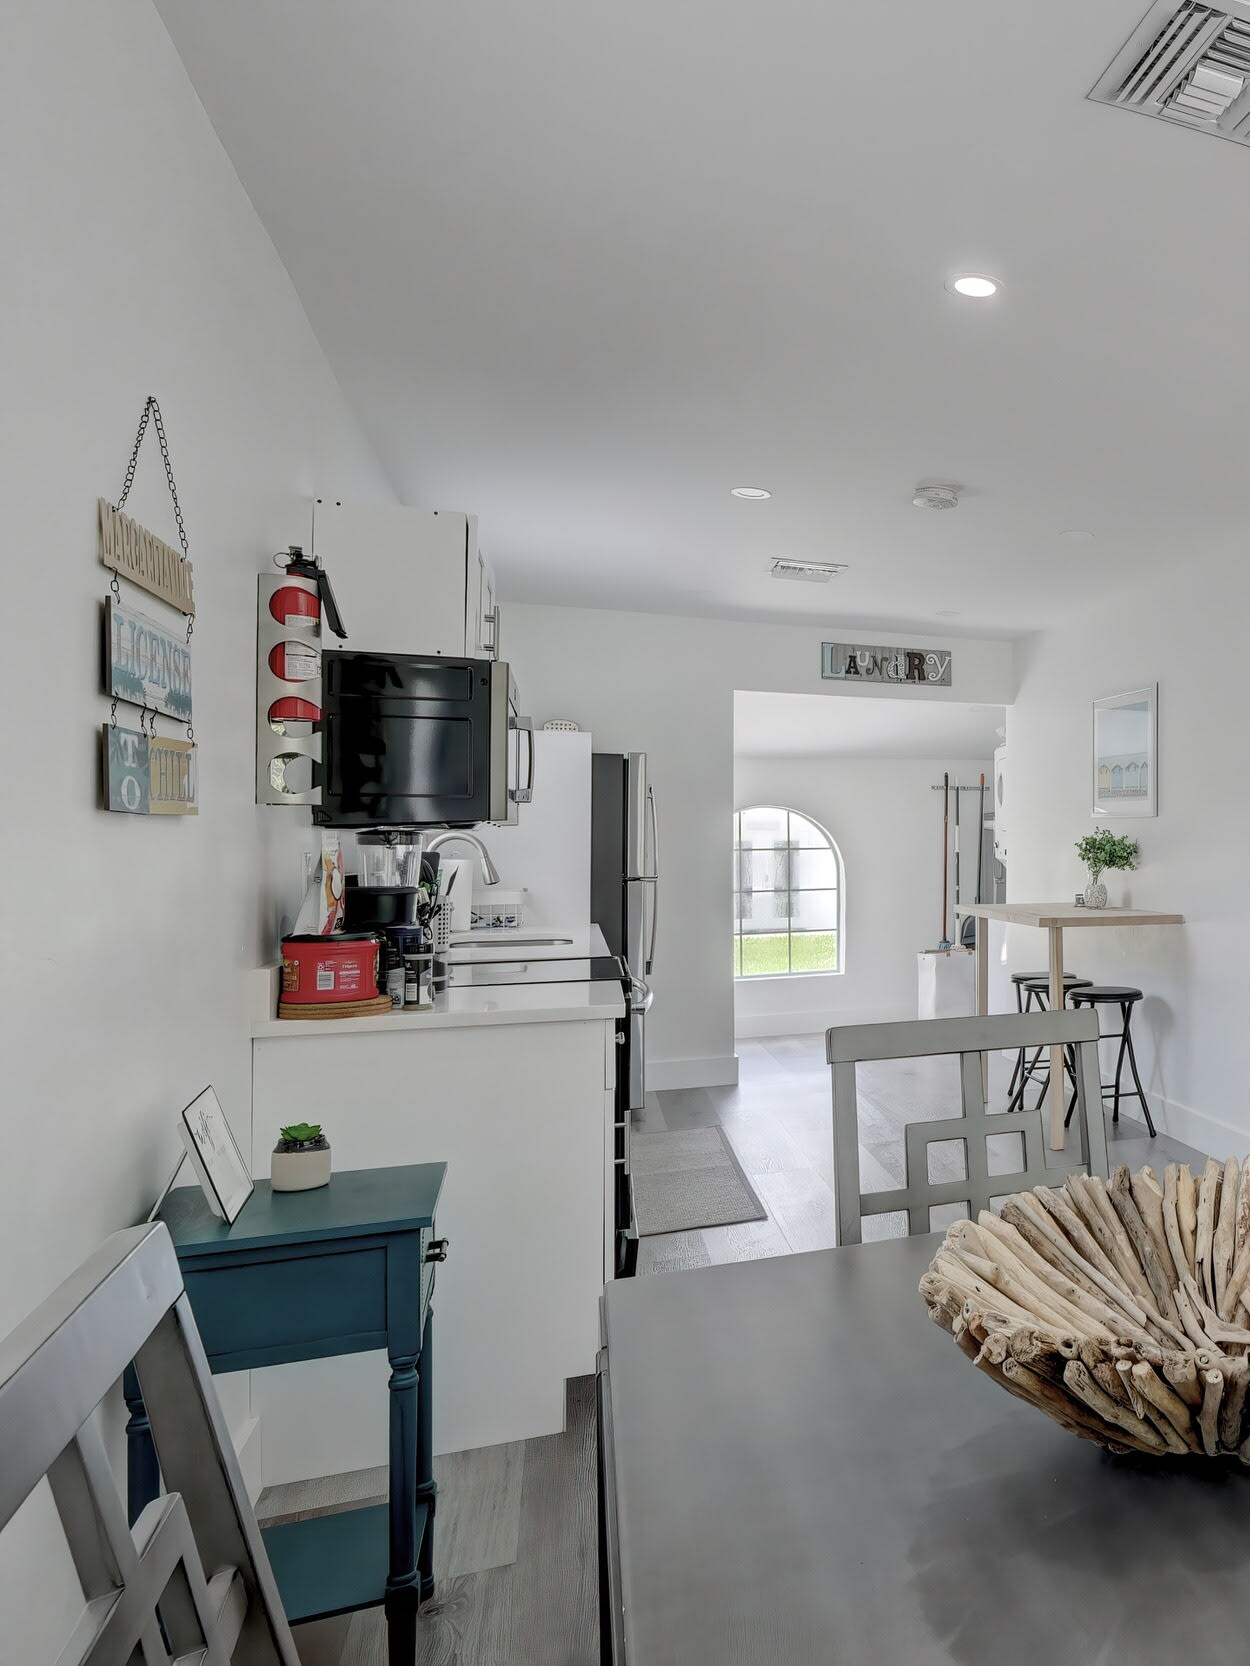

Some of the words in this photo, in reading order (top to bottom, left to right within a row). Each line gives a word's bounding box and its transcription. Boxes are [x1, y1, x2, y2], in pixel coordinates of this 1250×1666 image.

[113, 612, 191, 695] LICENSE
[120, 731, 141, 811] TO
[151, 748, 195, 803] CHILL
